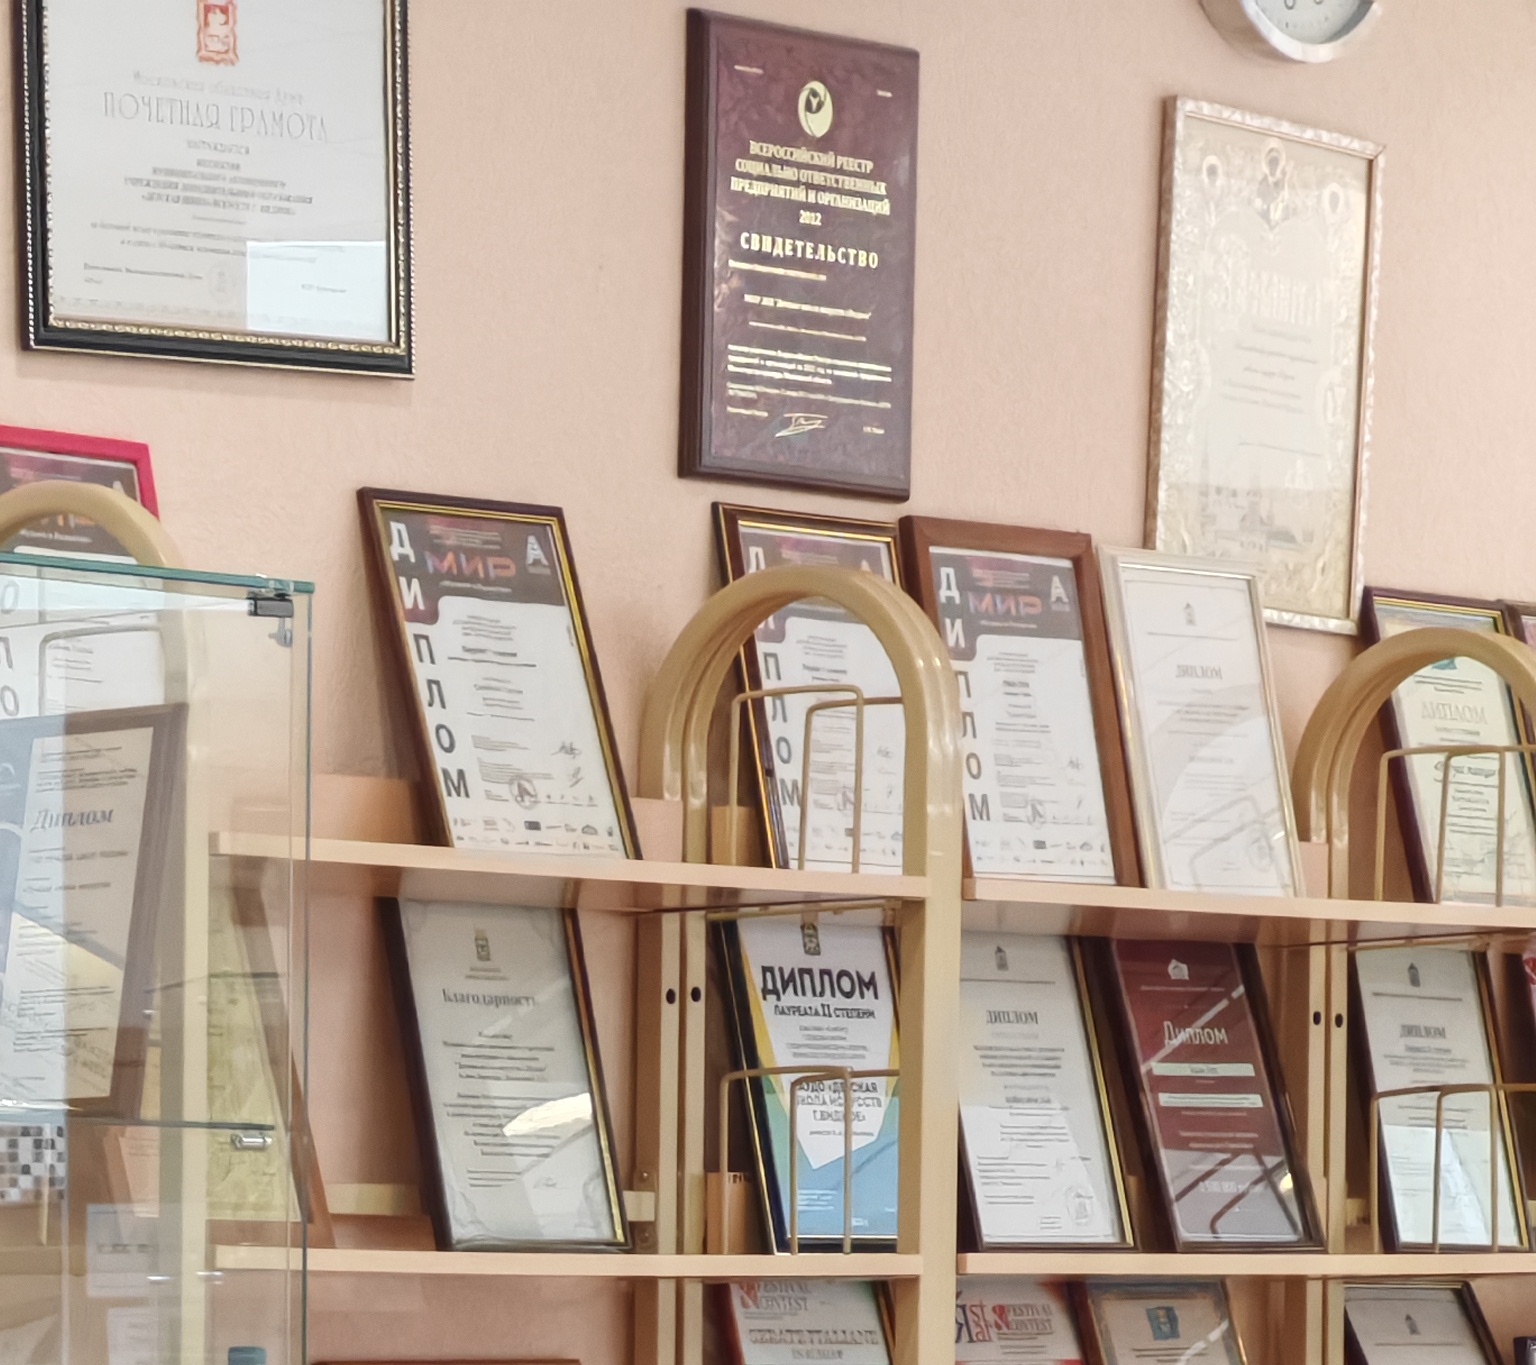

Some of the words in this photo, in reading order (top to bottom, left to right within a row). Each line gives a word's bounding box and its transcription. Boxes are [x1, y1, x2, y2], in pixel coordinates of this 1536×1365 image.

[103, 91, 220, 130] ПОЧЕТНАЯ
[229, 105, 328, 143] ГРАМОТА
[749, 140, 835, 169] ВСЕРОССИЙСКИЙ
[836, 155, 874, 174] РЕЕСТР
[735, 158, 798, 181] СОЦИАЛЬНО
[799, 169, 887, 195] ОТВЕТСТВЕННЫХ
[730, 176, 807, 203] ПРЕДПРИЯТИЙ
[817, 191, 891, 216] ОРГАНИЗАЦИЙ
[799, 209, 822, 226] 2012
[740, 231, 879, 269] СВИДЕТЕЛЬСТВО
[29, 808, 114, 833] Диплом
[761, 965, 879, 1002] ДИПЛОМ
[774, 1004, 821, 1017] ЛАУРЕАТА
[1163, 1020, 1229, 1046] Диплом
